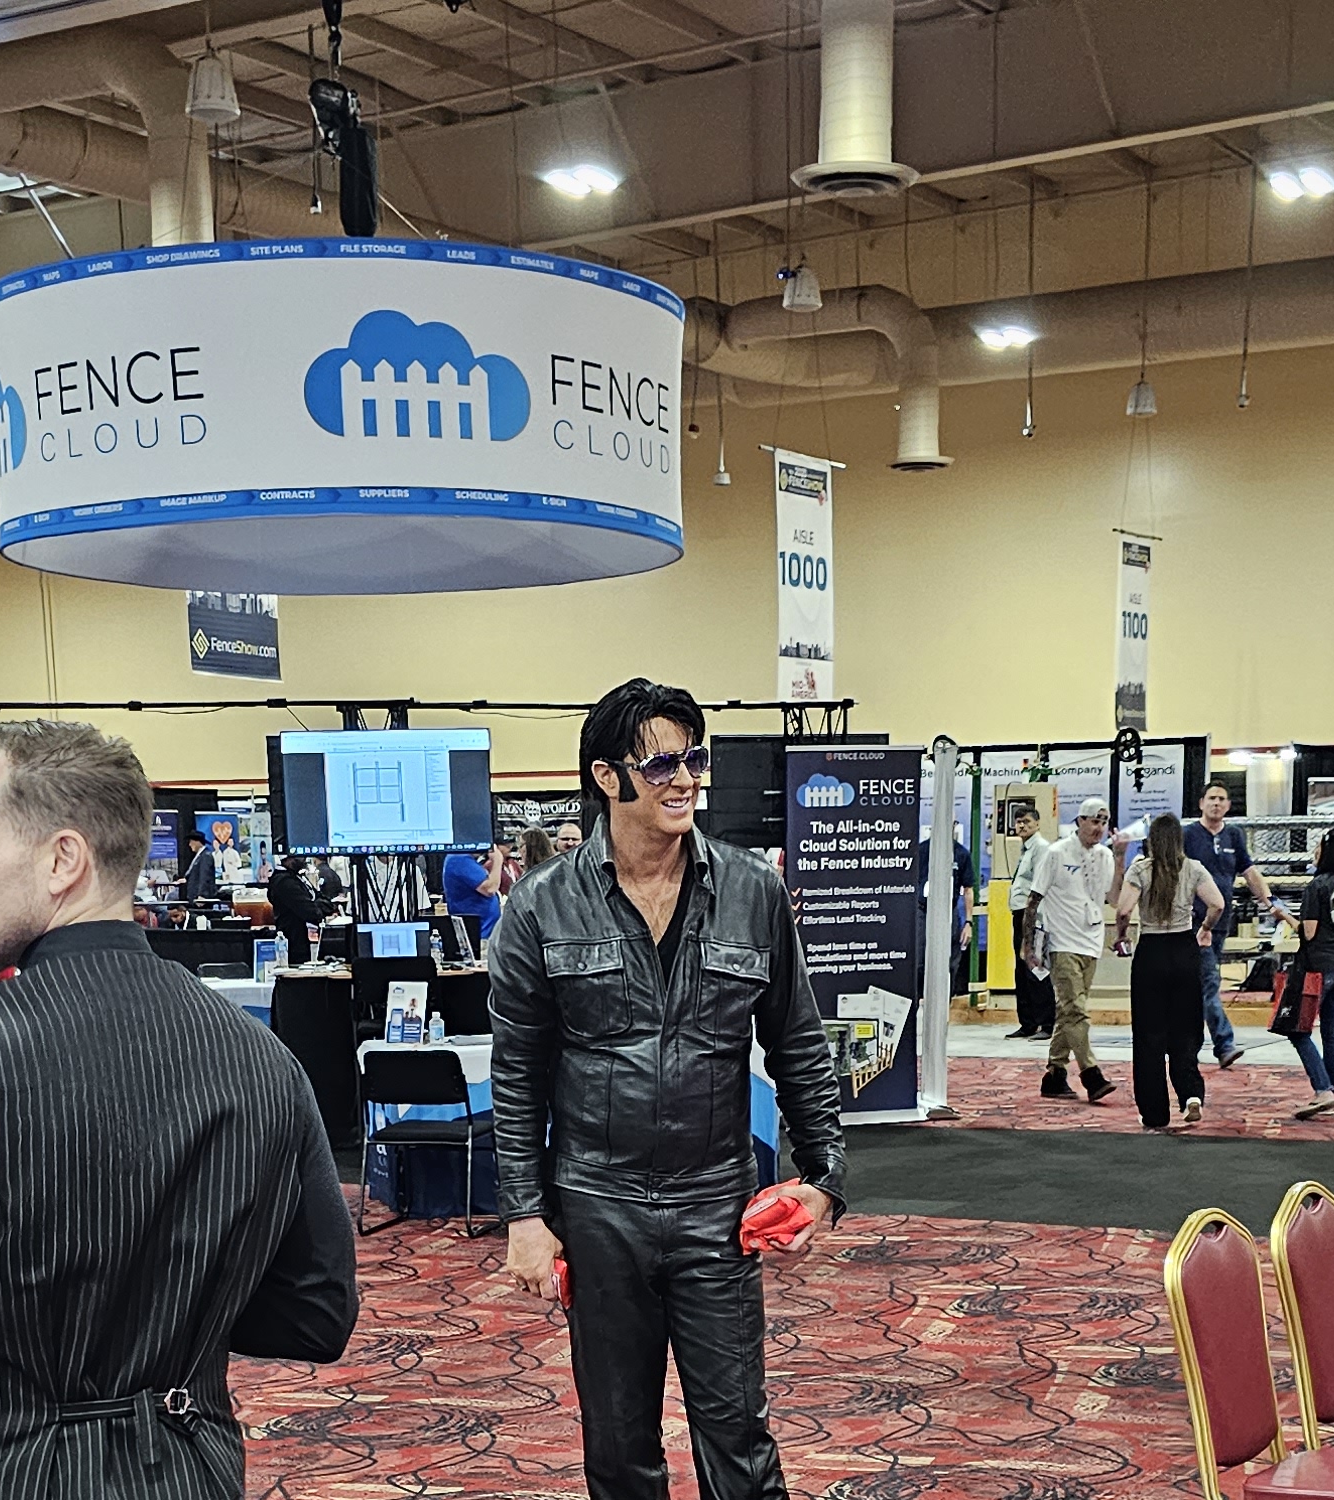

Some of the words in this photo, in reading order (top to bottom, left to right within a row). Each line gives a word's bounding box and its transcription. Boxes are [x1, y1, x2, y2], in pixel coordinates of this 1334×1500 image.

[250, 246, 270, 256] SITE
[272, 244, 304, 255] PLANS
[340, 243, 360, 254] FILE
[361, 244, 406, 255] STORAGE
[446, 249, 476, 261] LEADS
[146, 253, 170, 264] SHOP
[170, 249, 220, 262] DRAWINGS
[510, 255, 554, 270] ESTIMATES
[87, 260, 113, 273] LABOR
[34, 346, 204, 420] FENCE
[551, 354, 669, 434] FENCE
[40, 414, 207, 462] CLOUD
[553, 420, 670, 474] CLOUD
[260, 489, 316, 501] CONTRACTS
[359, 488, 410, 499] SUPPLIERS
[455, 490, 509, 502] SCHEDULING
[160, 496, 187, 507] IMAGE
[188, 493, 227, 505] MARKUP
[793, 529, 814, 546] AISLE
[779, 551, 827, 591] 1000
[1122, 611, 1148, 640] 1100
[210, 637, 277, 659] FenceShow.com
[791, 689, 818, 699] AMERICA
[983, 767, 1020, 777] Machin
[859, 779, 915, 795] FENCE
[859, 796, 915, 806] CLOUD
[497, 803, 524, 814] IRON
[540, 802, 581, 813] WORLD
[810, 821, 834, 834] The
[836, 820, 901, 834] All-in-One
[799, 838, 837, 853] Cloud
[838, 837, 891, 852] Solution
[892, 836, 911, 850] for
[797, 858, 818, 871] the
[820, 857, 859, 870] Fence
[861, 856, 913, 871] Industry
[833, 886, 874, 896] Breakdown
[874, 885, 882, 895] of
[883, 885, 915, 894] Materials
[851, 900, 880, 910] Reports
[836, 915, 855, 924] Lead
[856, 914, 887, 924] Tracking
[807, 943, 832, 953] Spend
[848, 941, 866, 950] time
[807, 953, 852, 963] calculations
[853, 952, 868, 961] and
[868, 952, 889, 960] more
[889, 951, 907, 959] time
[807, 964, 838, 976] growing
[838, 964, 856, 974] your
